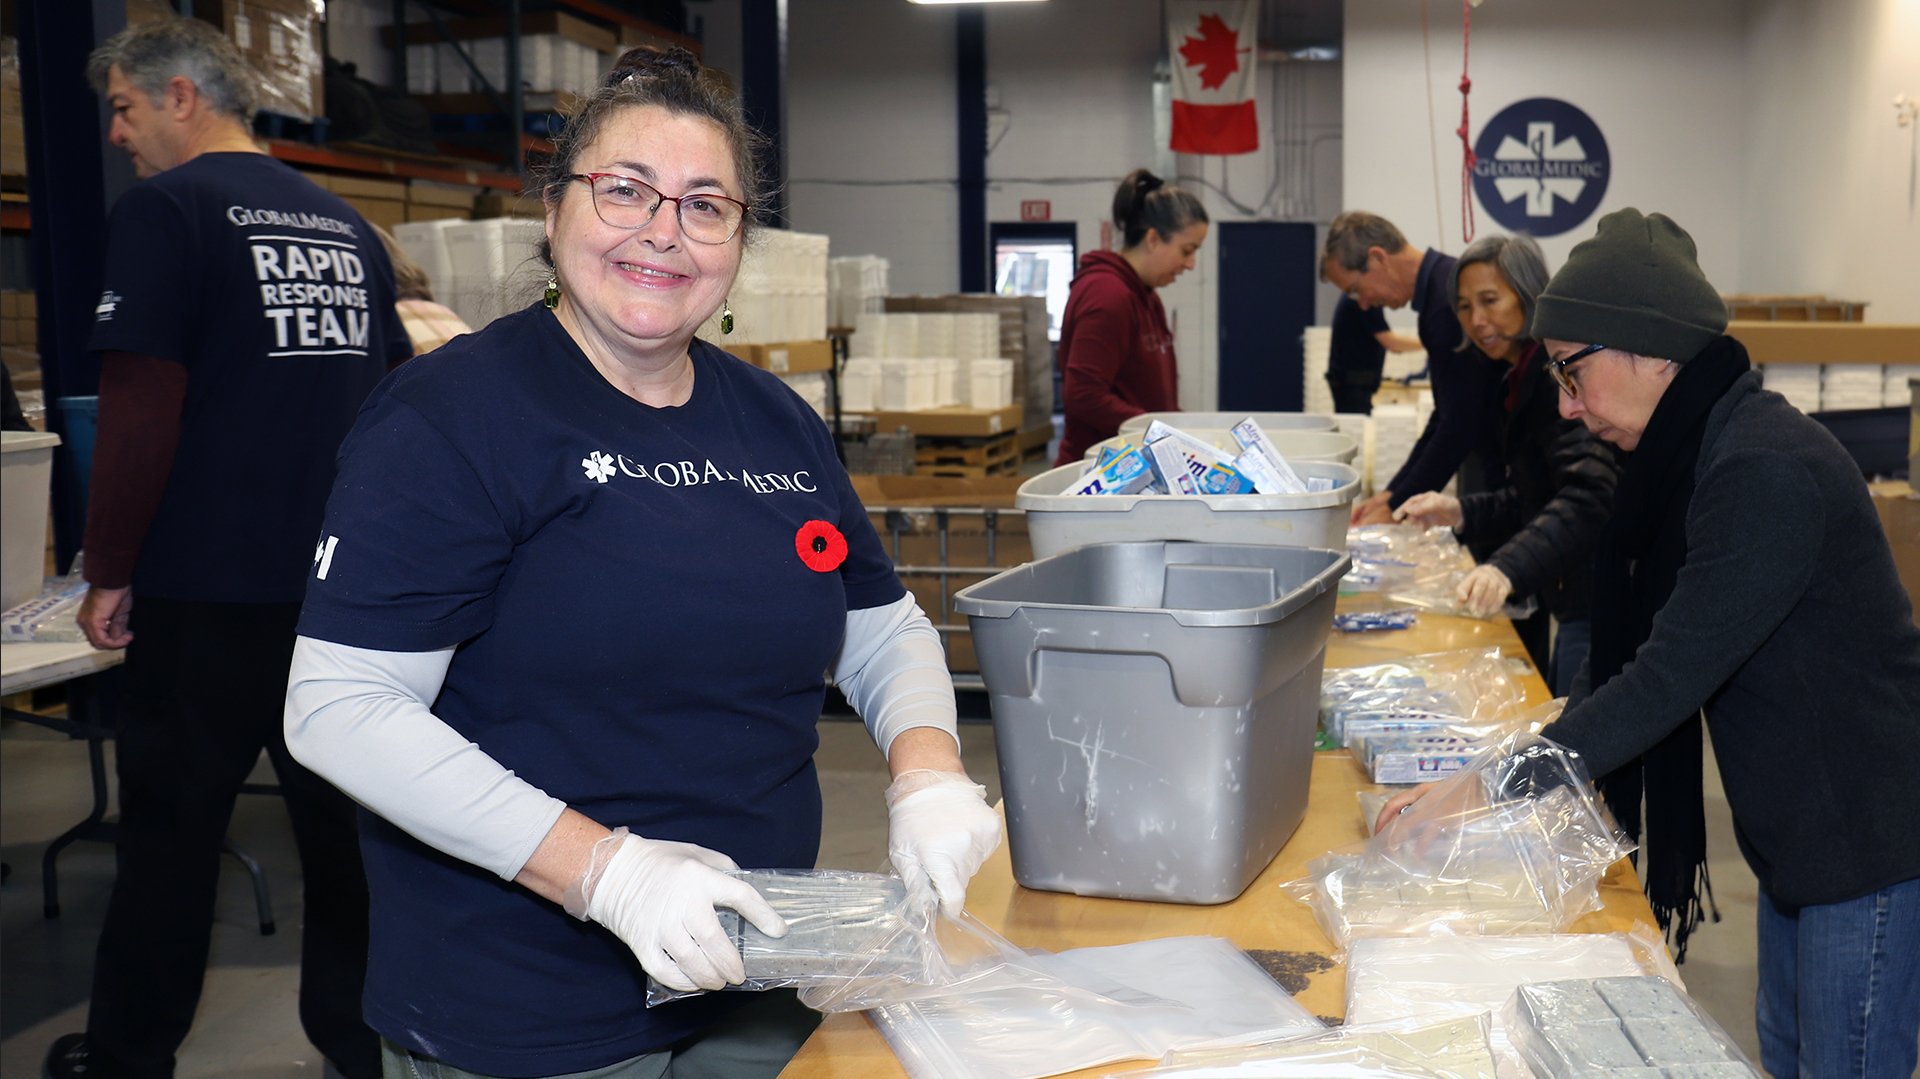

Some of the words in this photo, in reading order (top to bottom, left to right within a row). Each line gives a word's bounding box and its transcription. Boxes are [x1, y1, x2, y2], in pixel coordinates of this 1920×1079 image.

[252, 245, 365, 284] RAPID
[260, 283, 369, 309] RESPONSE
[264, 307, 370, 348] TEAM
[1182, 451, 1207, 477] im
